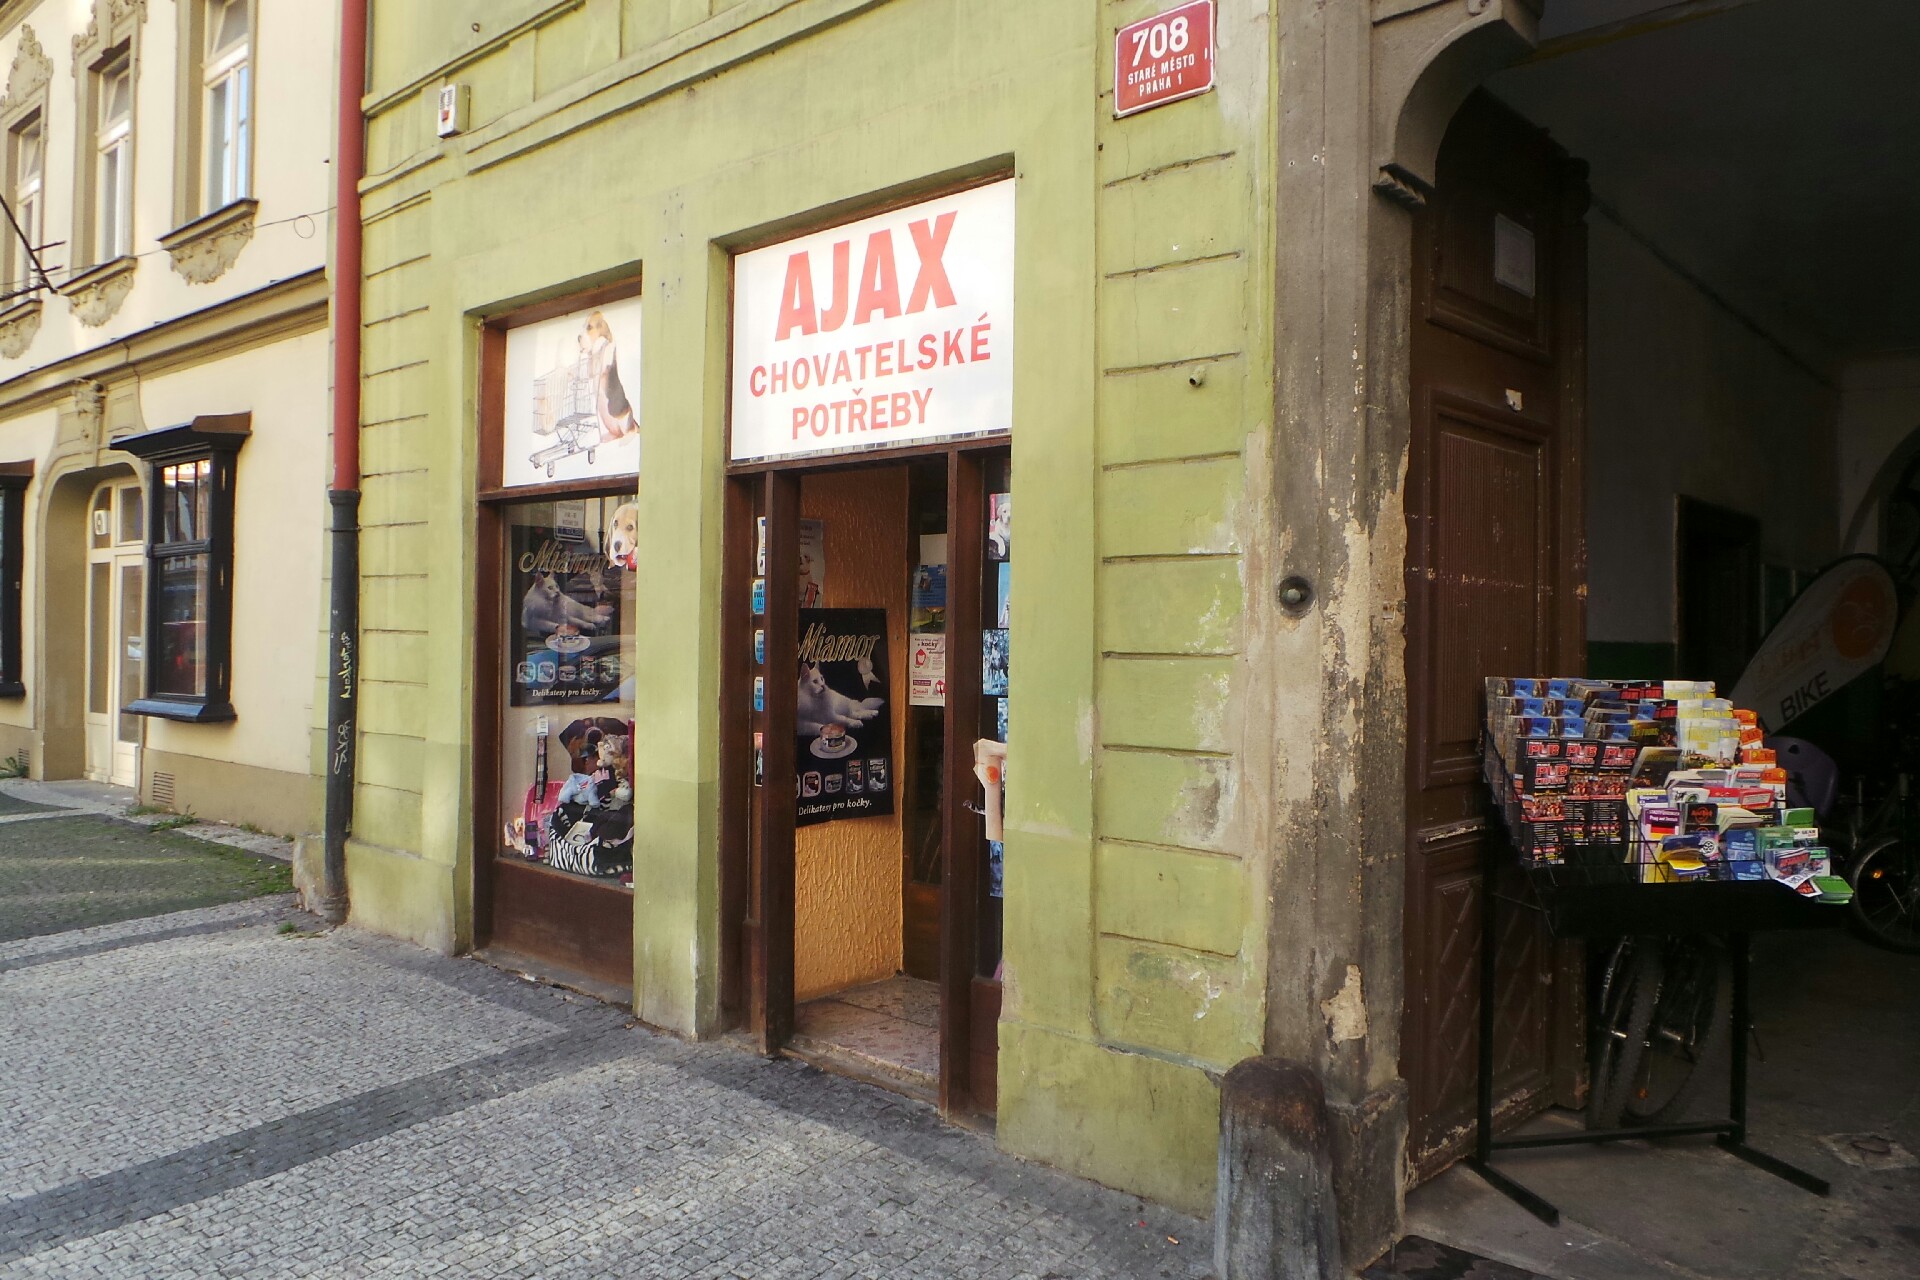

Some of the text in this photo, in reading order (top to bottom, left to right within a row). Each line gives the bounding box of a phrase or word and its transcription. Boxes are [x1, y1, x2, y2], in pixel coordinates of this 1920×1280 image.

[1132, 16, 1189, 67] 708
[1128, 53, 1195, 85] STARÉ MĚSTO
[1139, 73, 1182, 97] PRAHA 1
[775, 210, 958, 342] AJAX
[749, 312, 991, 397] CHOVATELSKÉ
[792, 387, 933, 440] POTŘEBY
[798, 622, 881, 663] Miamor
[532, 688, 566, 698] Delikatesy
[567, 688, 580, 698] pro
[1780, 670, 1832, 723] BIKE
[1528, 744, 1560, 756] PUB
[1566, 744, 1598, 757] PUB
[1535, 765, 1568, 777] PUB
[798, 804, 831, 816] Delikatesy
[832, 801, 845, 811] pro
